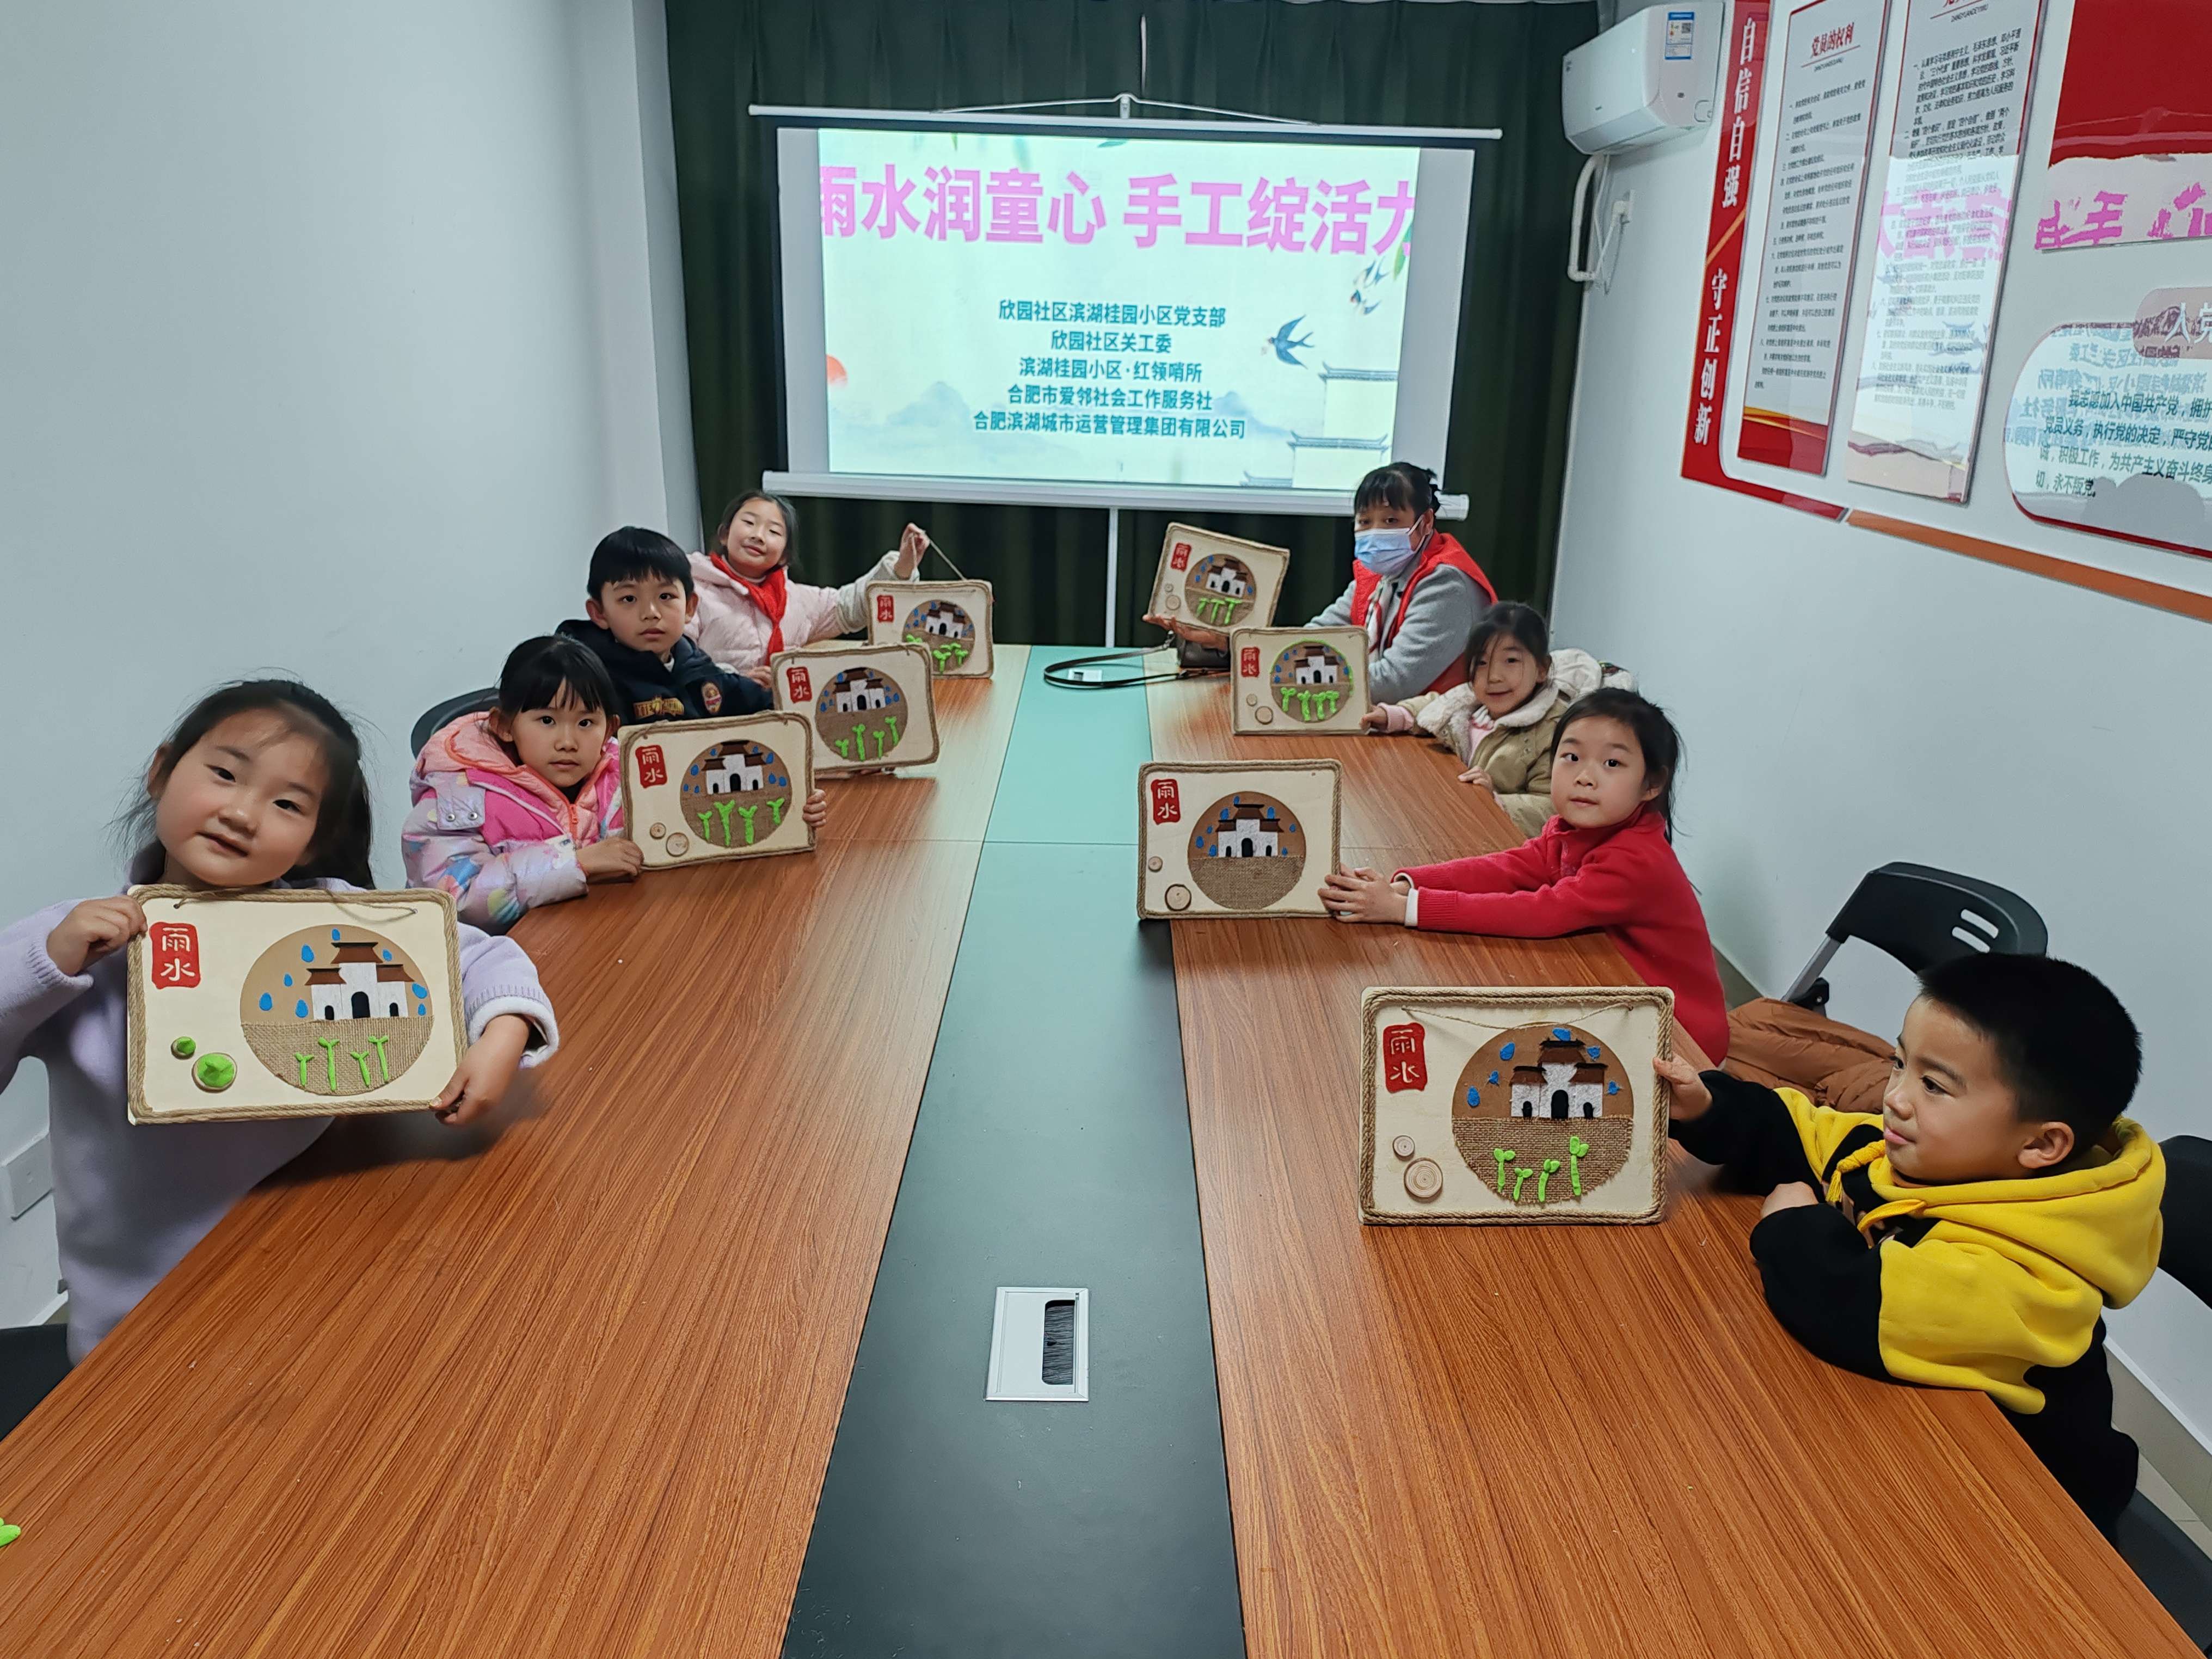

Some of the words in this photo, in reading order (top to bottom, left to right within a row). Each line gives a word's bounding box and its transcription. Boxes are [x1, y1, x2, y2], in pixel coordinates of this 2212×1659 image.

[1722, 17, 1756, 208] 自信自强
[820, 163, 1106, 244] 雨水润童心
[1123, 173, 1415, 256] 手工绽活力
[998, 299, 1226, 328] 欣园社区滨湖桂园小区党支部
[1050, 330, 1172, 354] 欣园社区关工委
[1693, 267, 1728, 446] 守正创新
[1019, 357, 1202, 383] 滨湖桂园小区·红领哨所
[1007, 384, 1213, 410] 合肥市爱邻社会工作服务社
[973, 411, 1246, 439] 合肥滨湖城市运营管理集团有限公司
[2044, 415, 2212, 452] 党员义务，执行党的决定，严守党
[879, 596, 893, 620] 雨水
[790, 669, 810, 701] 雨水
[641, 746, 663, 785] 雨水
[1157, 782, 1178, 819] 雨水
[160, 927, 196, 981] 雨水
